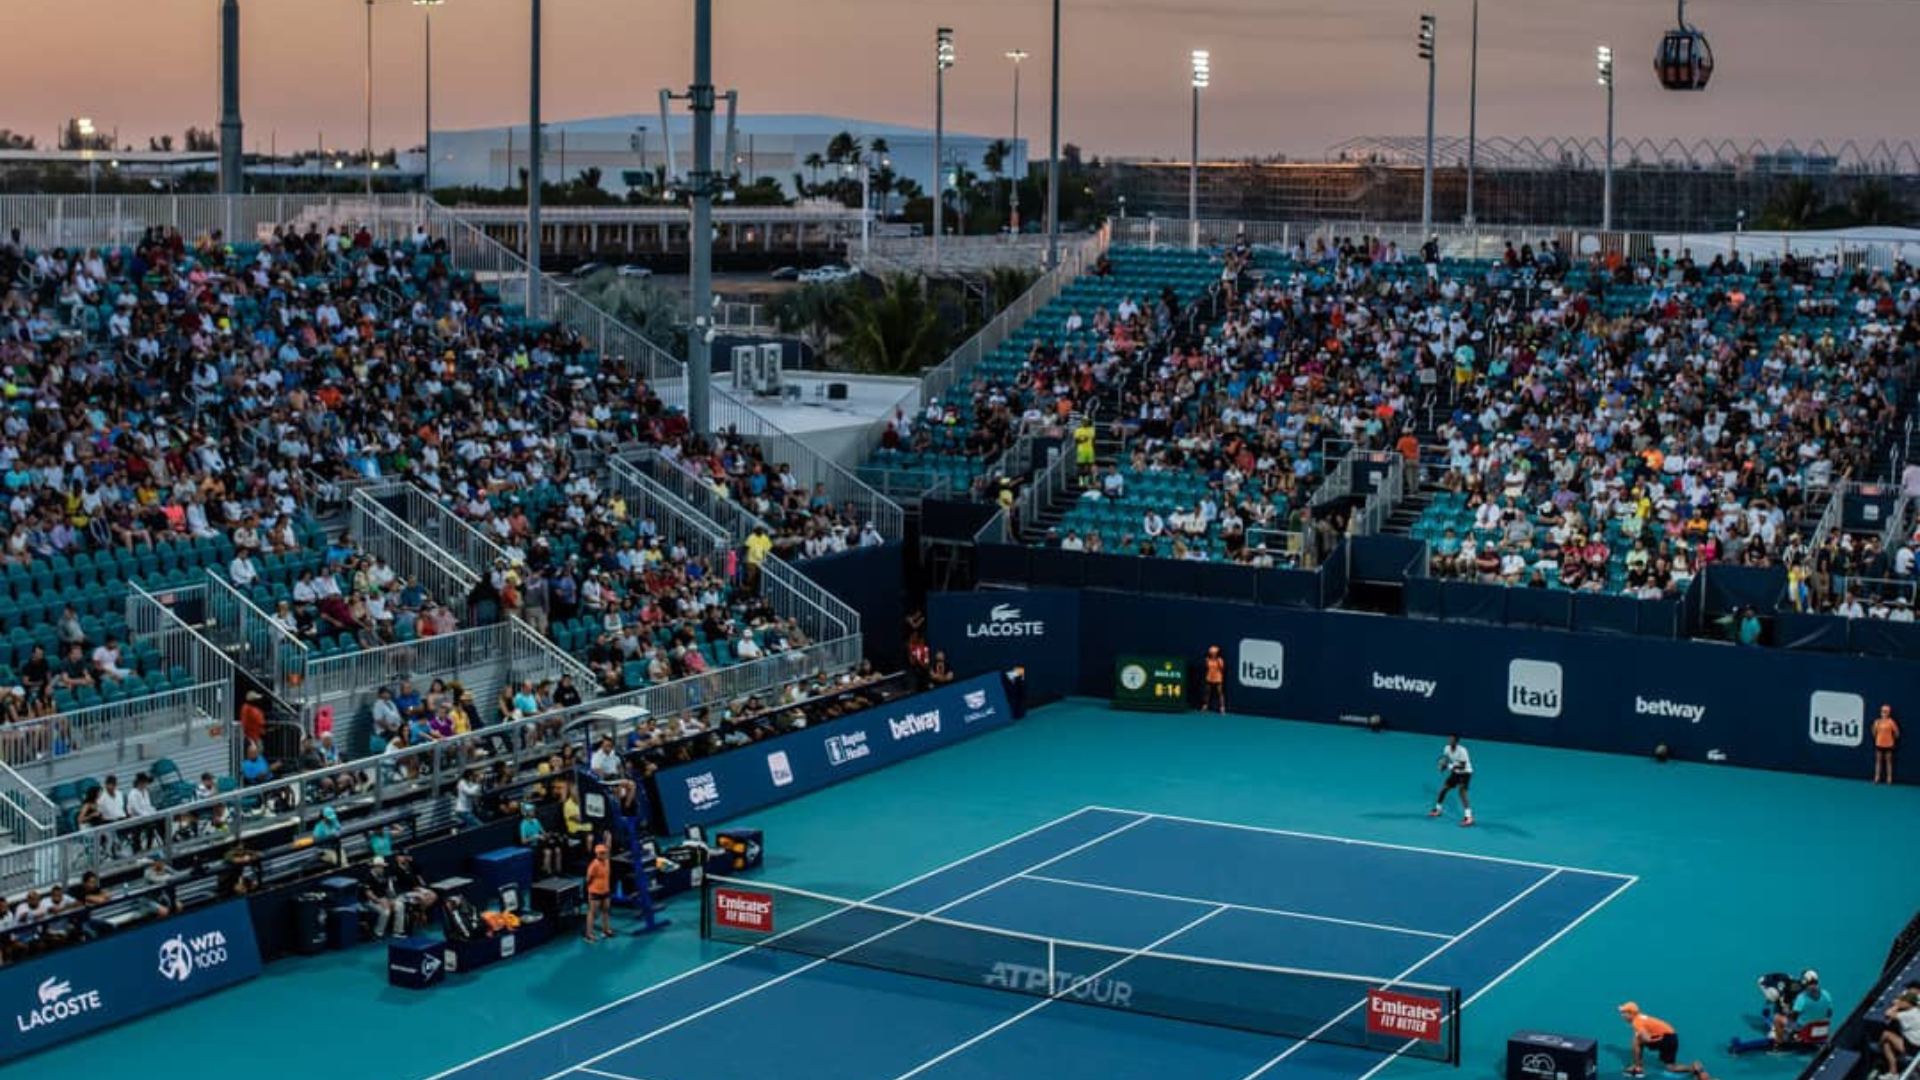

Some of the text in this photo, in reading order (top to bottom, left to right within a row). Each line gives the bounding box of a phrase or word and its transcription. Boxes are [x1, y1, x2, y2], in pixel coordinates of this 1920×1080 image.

[967, 621, 1044, 637] LACOSTE
[1241, 660, 1280, 681] Itaú
[1373, 671, 1437, 698] betway
[1512, 685, 1558, 708] Itaú
[1635, 695, 1706, 723] betway
[888, 709, 941, 740] betway
[1814, 716, 1859, 738] Itaú
[845, 744, 870, 760] Health
[689, 782, 719, 804] ONE
[718, 894, 772, 914] Emirates
[189, 930, 227, 951] WTA
[194, 947, 227, 969] 1000
[982, 961, 1133, 1007] ATP TOUR
[17, 990, 102, 1032] LACOSTE
[1371, 996, 1441, 1021] Emirates
[1381, 1014, 1427, 1033] FLY BETTER
